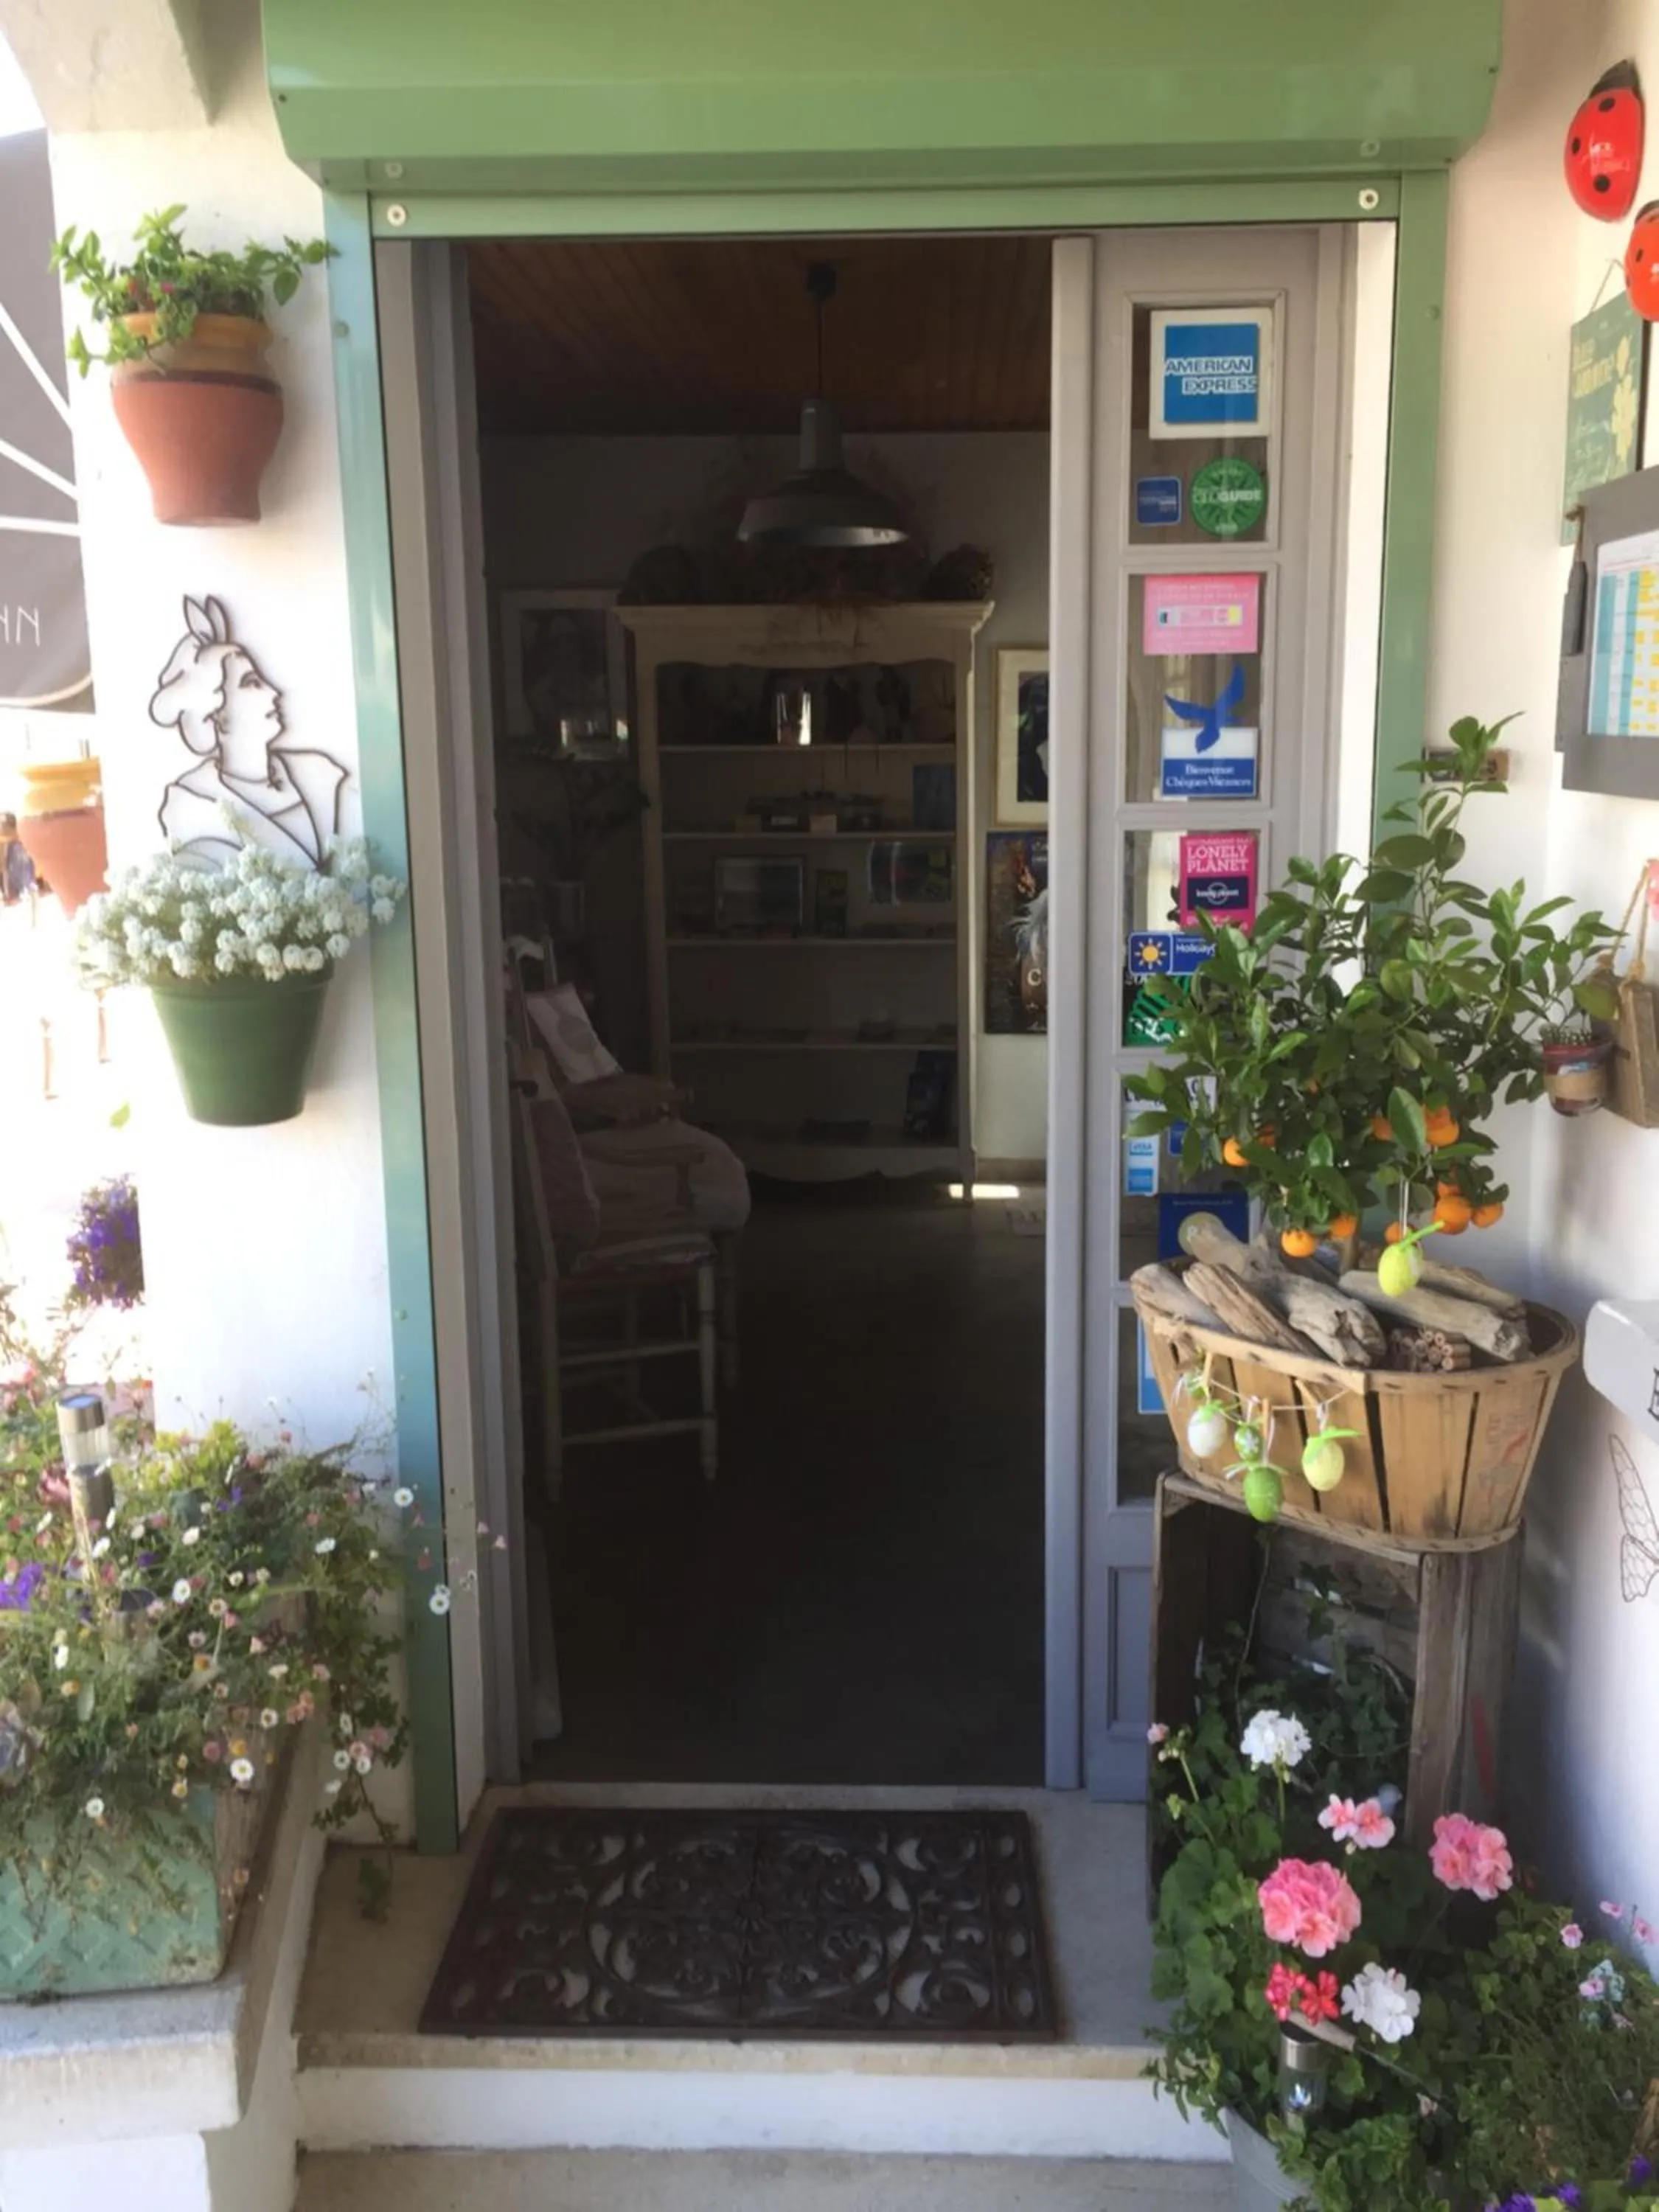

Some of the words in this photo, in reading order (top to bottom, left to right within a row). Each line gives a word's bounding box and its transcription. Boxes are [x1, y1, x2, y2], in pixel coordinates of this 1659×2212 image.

[1165, 357, 1253, 375] AMERICAN
[1183, 376, 1257, 394] EXPRESS
[1187, 845, 1247, 858] LONELY
[1187, 858, 1248, 873] PLANET
